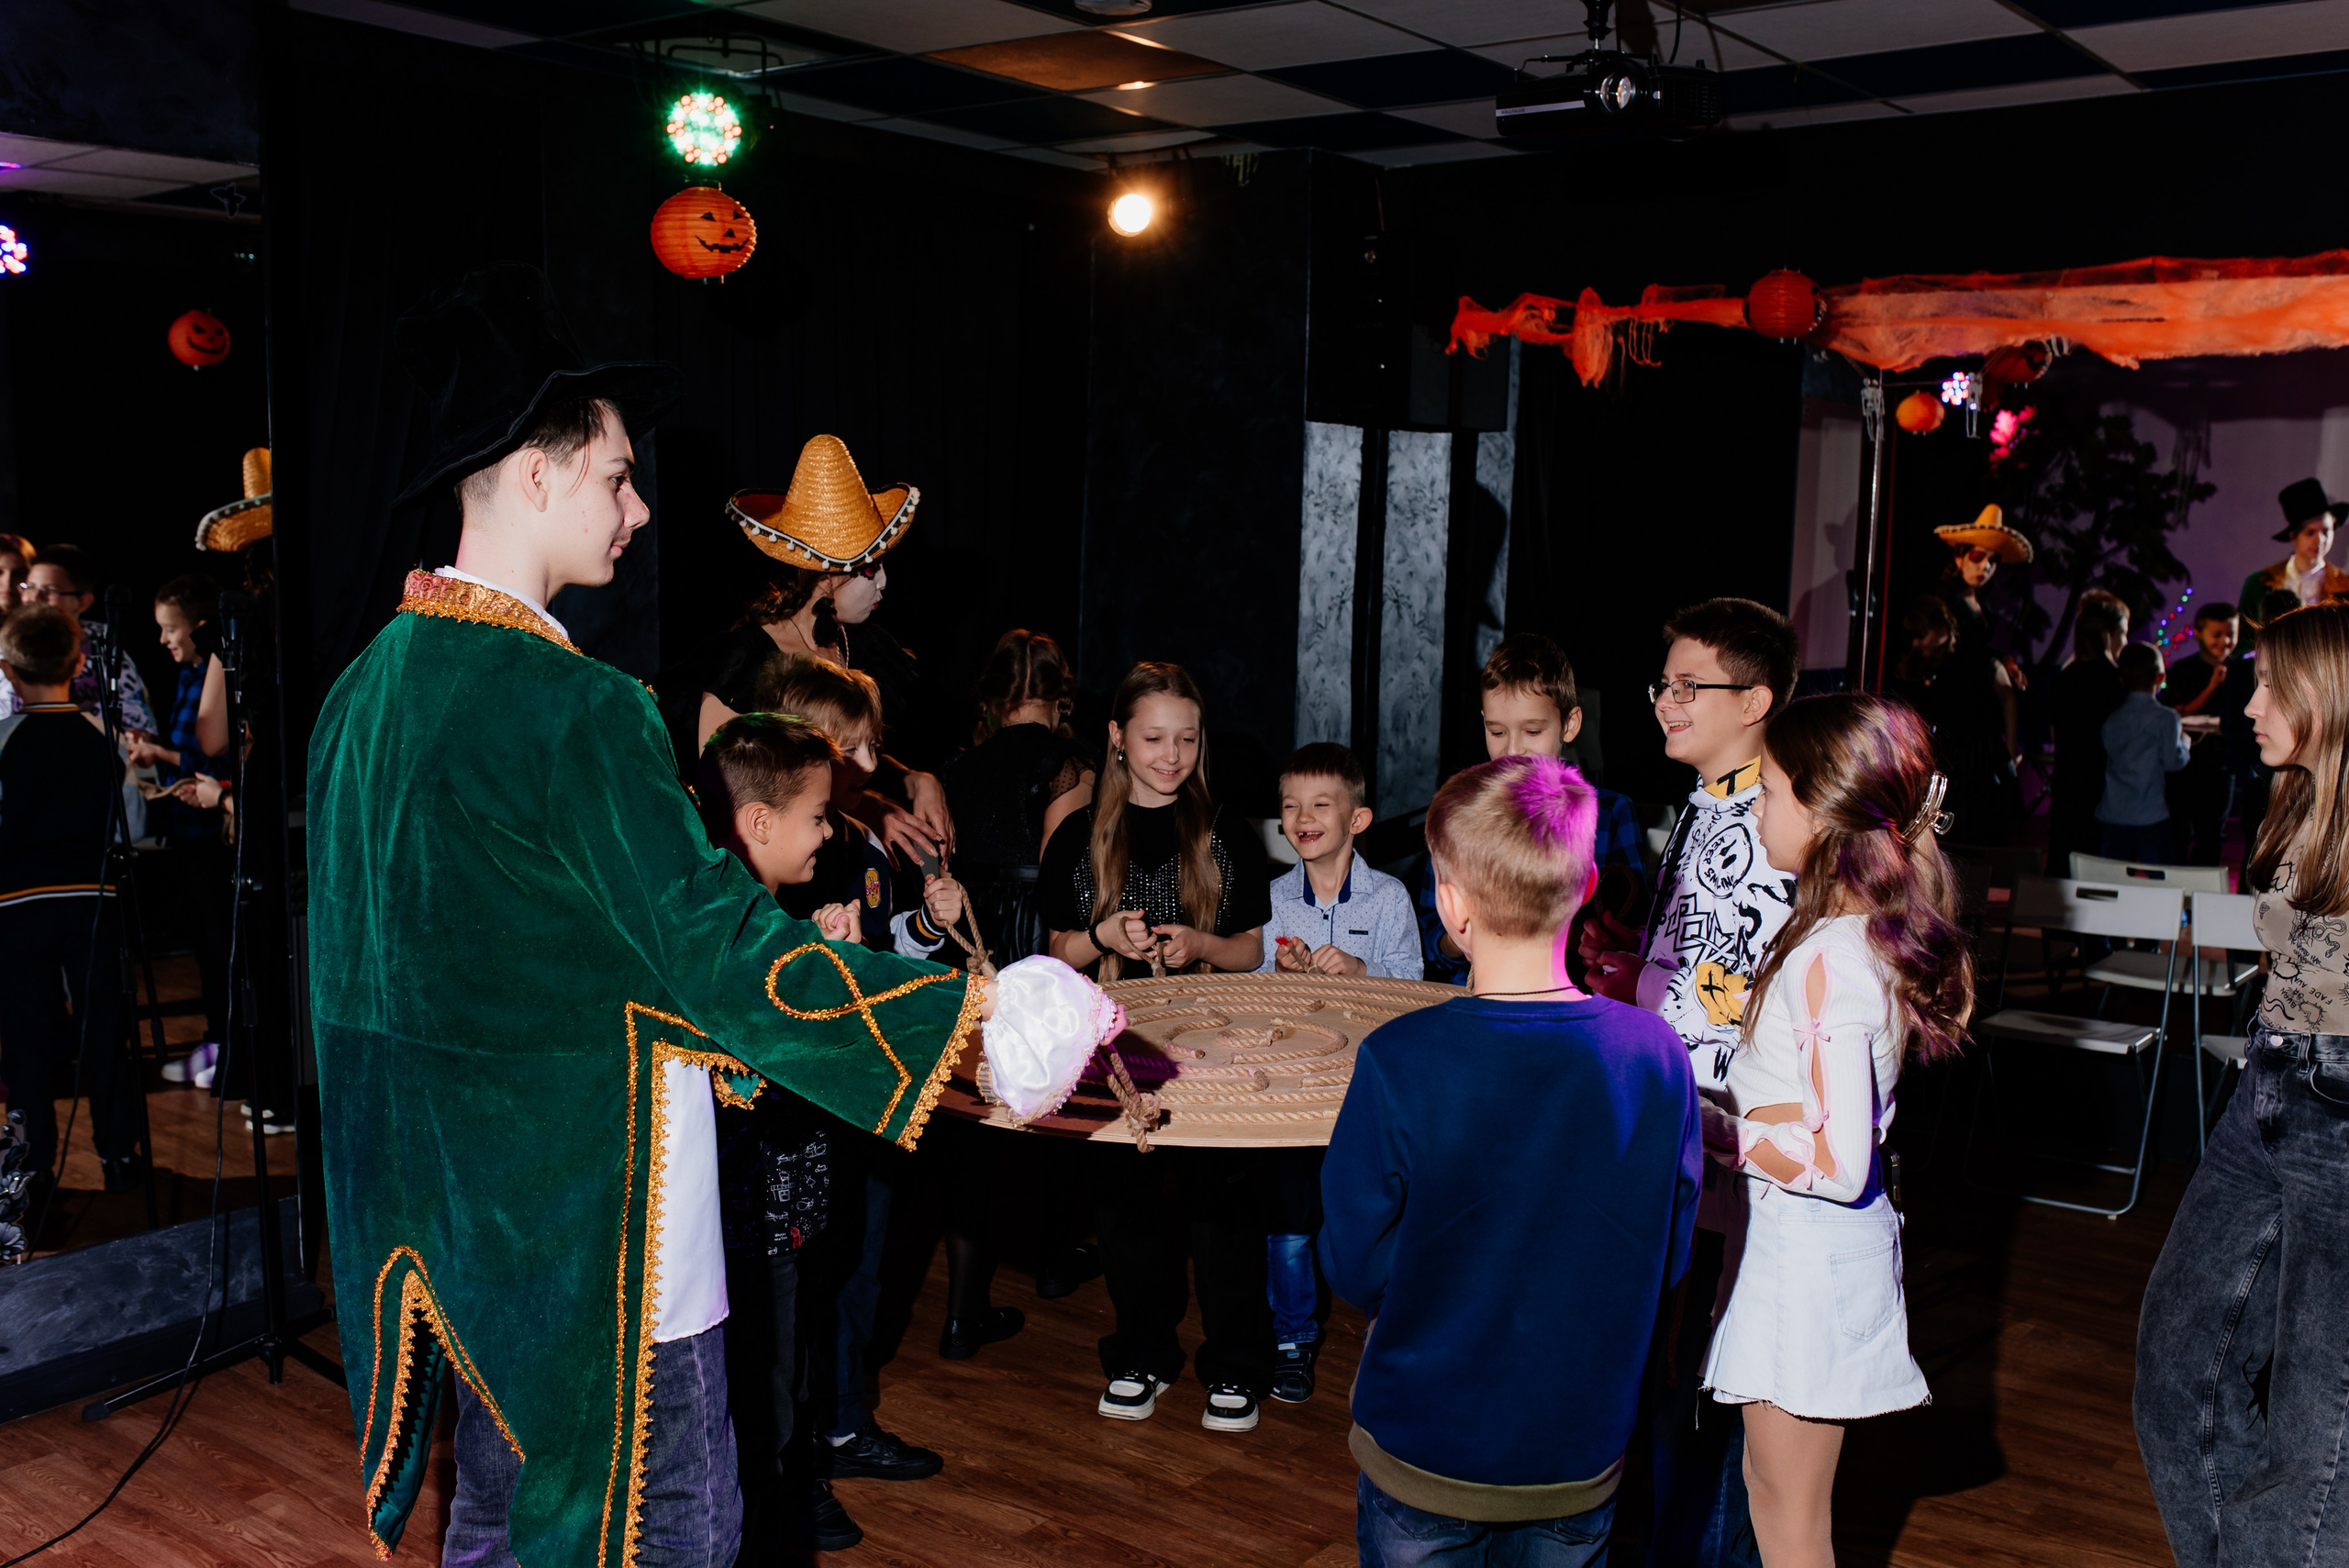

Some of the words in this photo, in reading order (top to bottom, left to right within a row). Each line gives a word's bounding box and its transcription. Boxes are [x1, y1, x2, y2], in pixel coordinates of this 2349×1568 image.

[1703, 835, 1726, 865] KEEP
[2279, 987, 2297, 1009] BURN
[2308, 987, 2333, 1006] FADE
